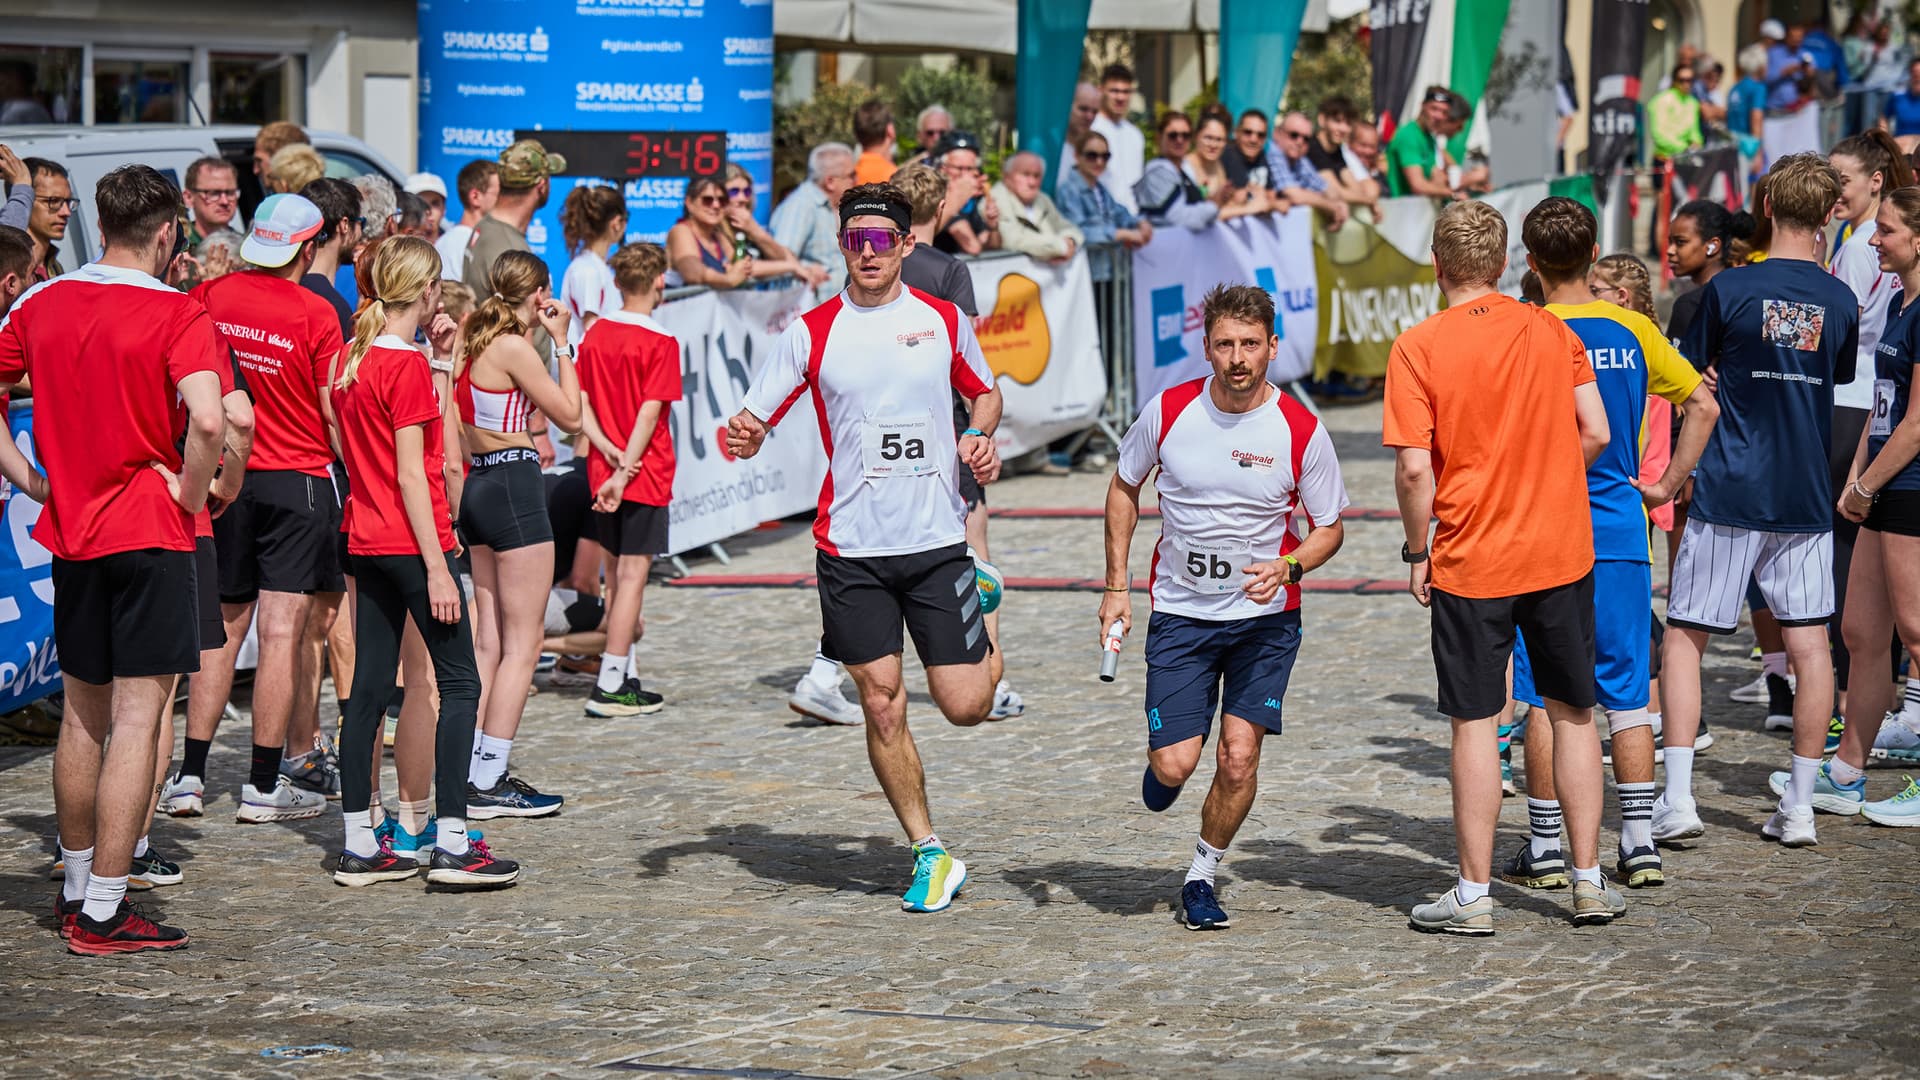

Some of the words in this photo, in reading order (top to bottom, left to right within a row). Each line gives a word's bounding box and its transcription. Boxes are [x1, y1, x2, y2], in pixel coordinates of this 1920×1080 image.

[443, 31, 528, 51] SPARKASSE
[576, 82, 684, 101] SPARKASSE
[442, 127, 514, 147] SPARKASS
[626, 134, 720, 175] 3:46
[880, 433, 925, 460] 5a
[484, 450, 520, 466] NIKE
[522, 450, 540, 462] PR
[1231, 449, 1275, 465] Gottwald
[1186, 550, 1232, 579] 5b
